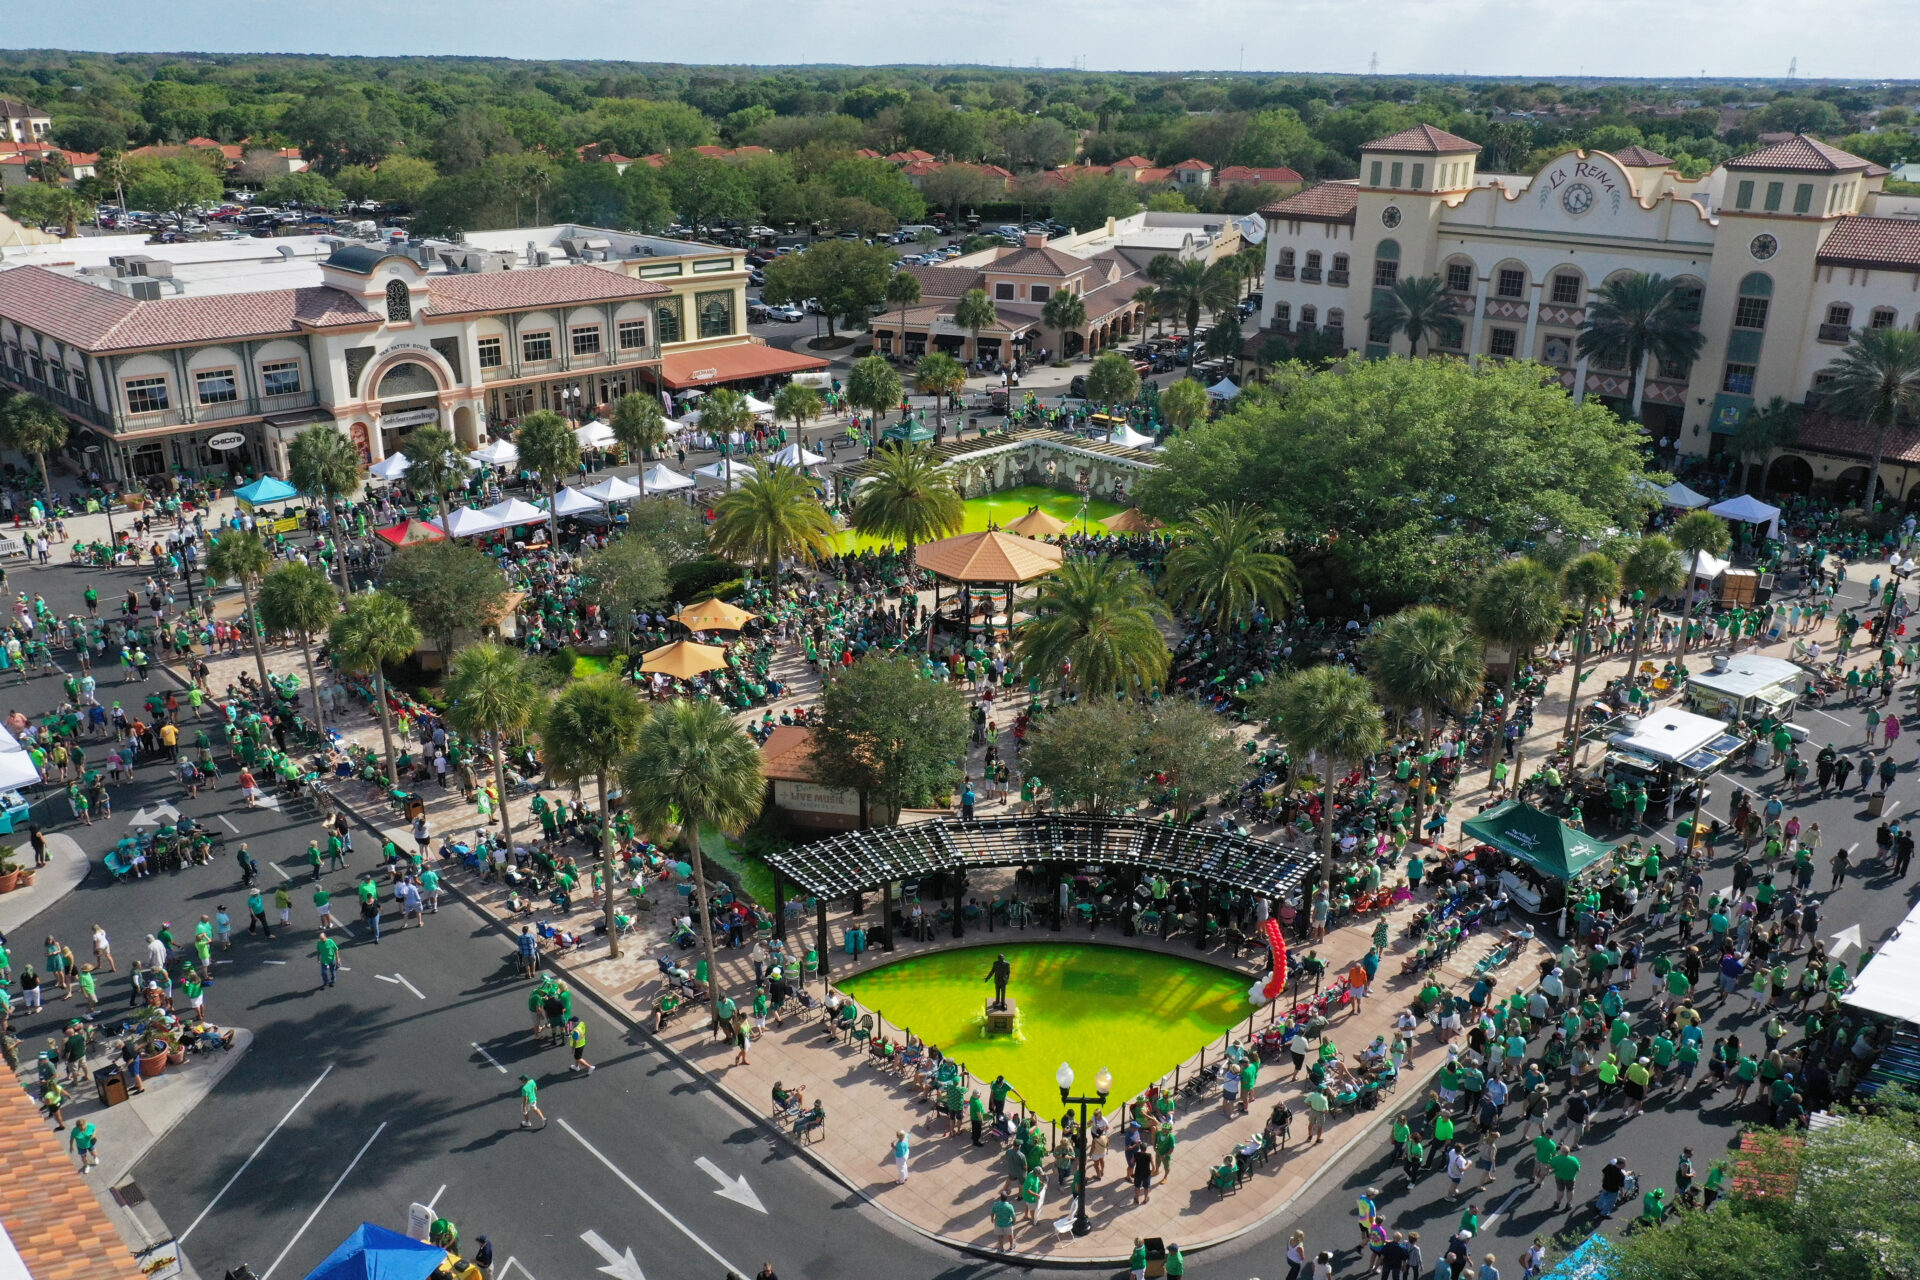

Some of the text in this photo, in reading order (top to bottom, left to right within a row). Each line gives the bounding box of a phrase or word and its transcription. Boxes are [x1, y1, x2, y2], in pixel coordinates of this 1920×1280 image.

[1550, 162, 1616, 193] LA REINA
[212, 436, 242, 446] CHICO'S
[791, 792, 845, 805] LIVE MUSIC
